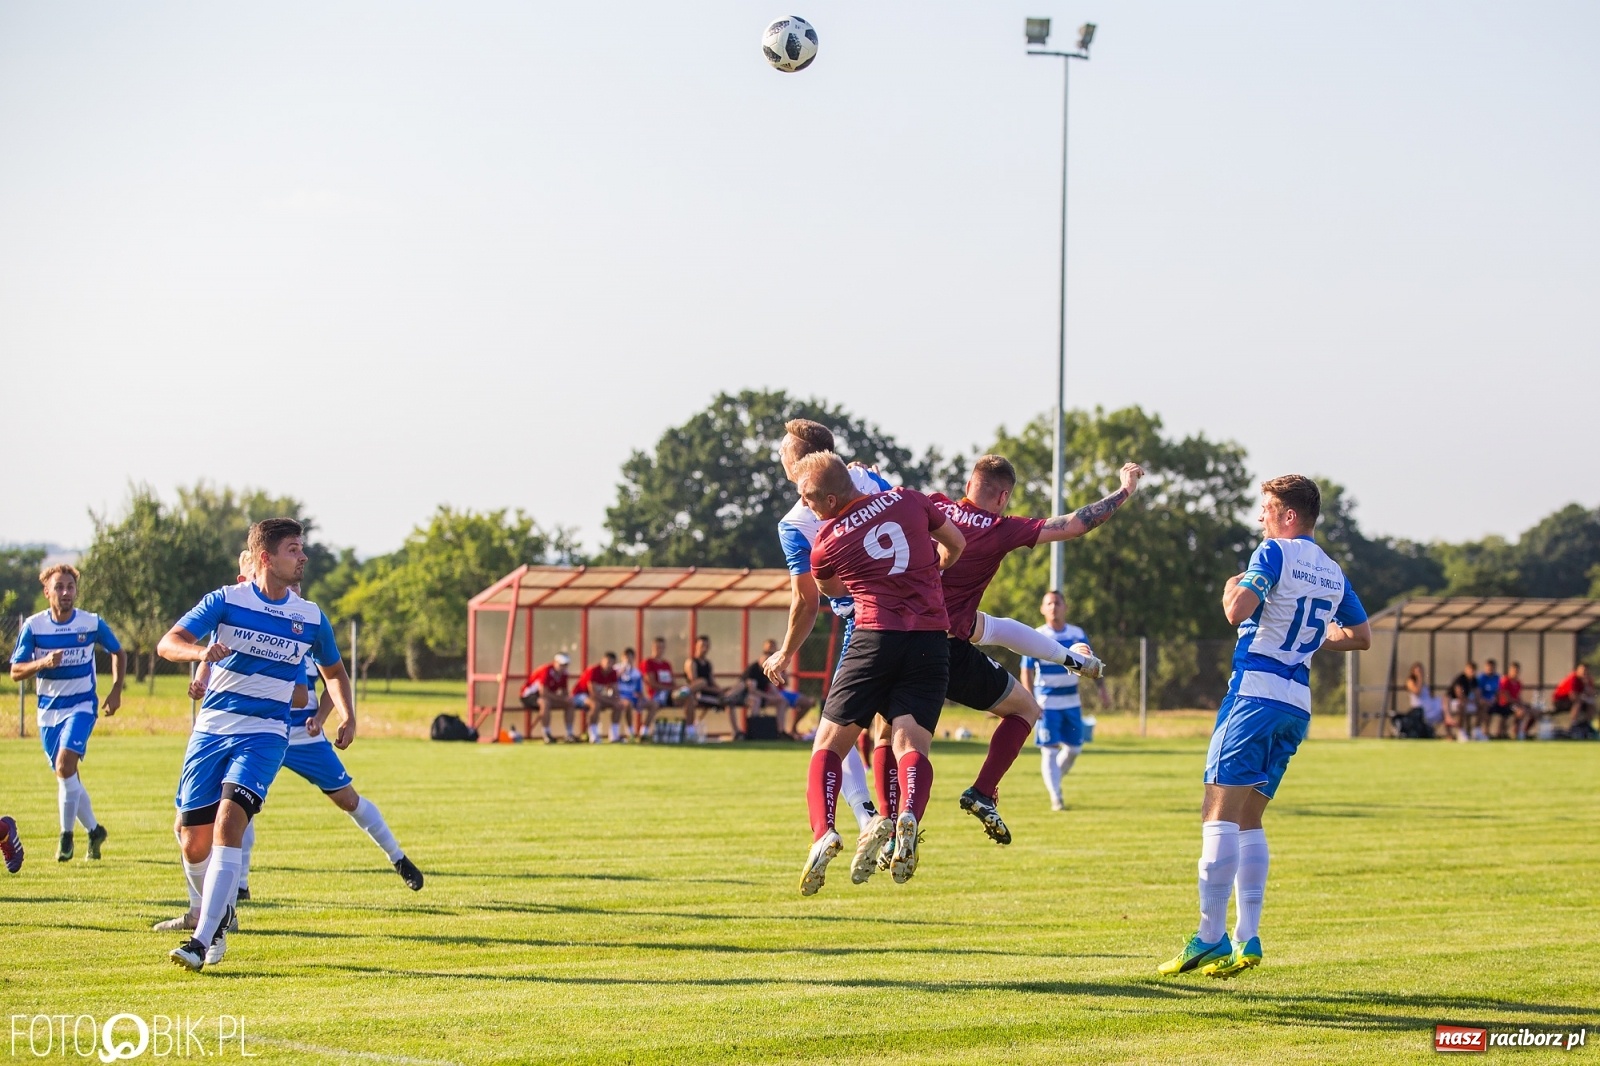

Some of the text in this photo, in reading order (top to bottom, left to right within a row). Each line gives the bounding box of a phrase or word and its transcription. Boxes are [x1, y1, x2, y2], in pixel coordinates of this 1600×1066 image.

[833, 491, 903, 537] CZERNICA
[863, 521, 910, 576] 9
[1252, 574, 1268, 590] C
[233, 629, 292, 649] MW SPORT
[1279, 596, 1333, 653] 15
[250, 645, 288, 661] Racibórz
